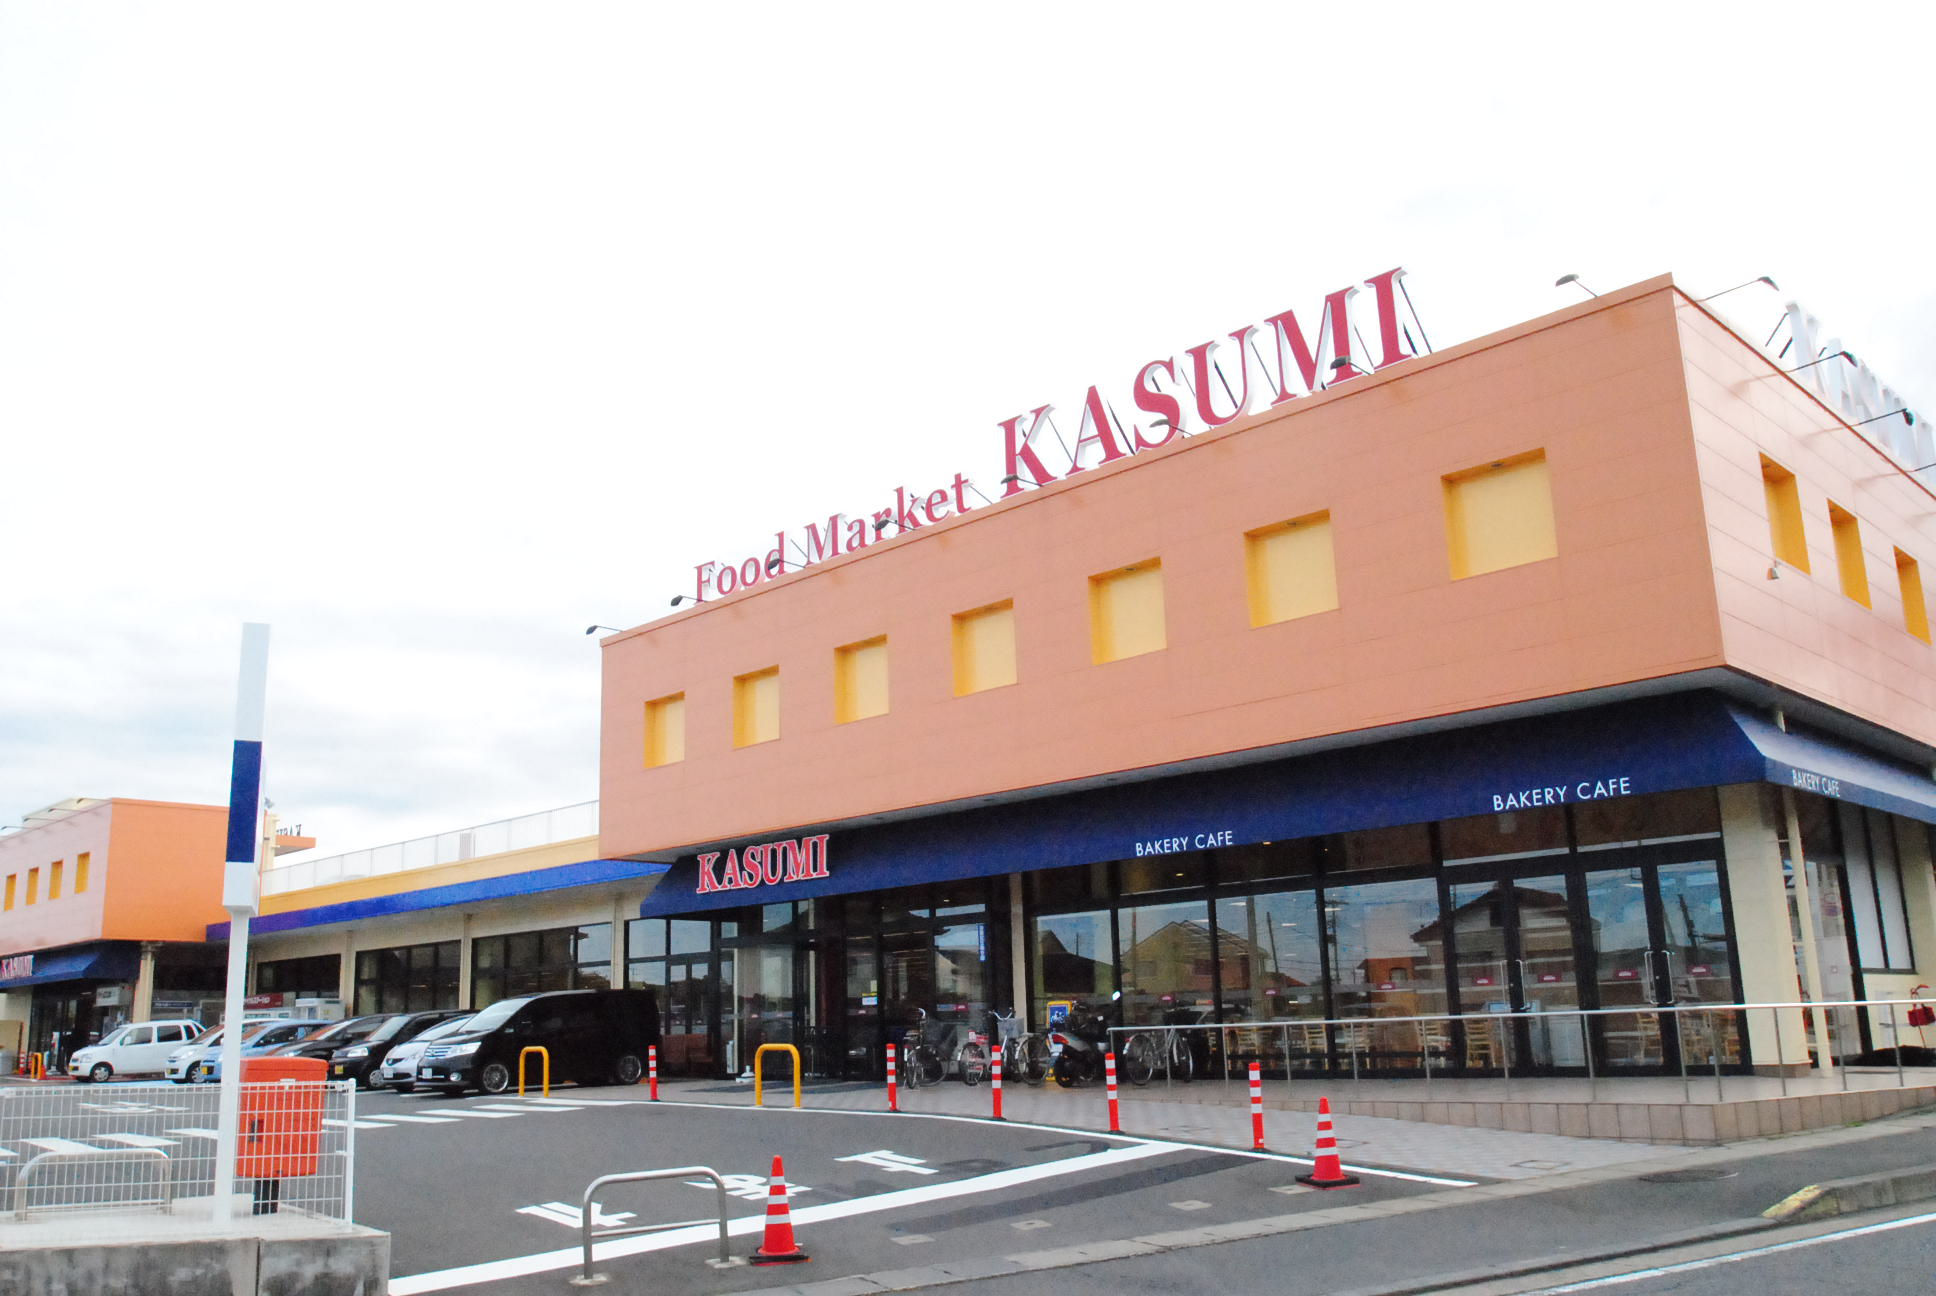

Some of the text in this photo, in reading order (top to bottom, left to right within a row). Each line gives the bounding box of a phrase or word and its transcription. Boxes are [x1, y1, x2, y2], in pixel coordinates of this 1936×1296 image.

[692, 266, 1414, 604] Food Market KASUMI
[1492, 777, 1632, 812] BAKERY CAFE
[1791, 767, 1841, 798] BAKERY CAFE
[1135, 830, 1234, 857] BAKERY CAFE
[696, 834, 830, 894] KASUMI
